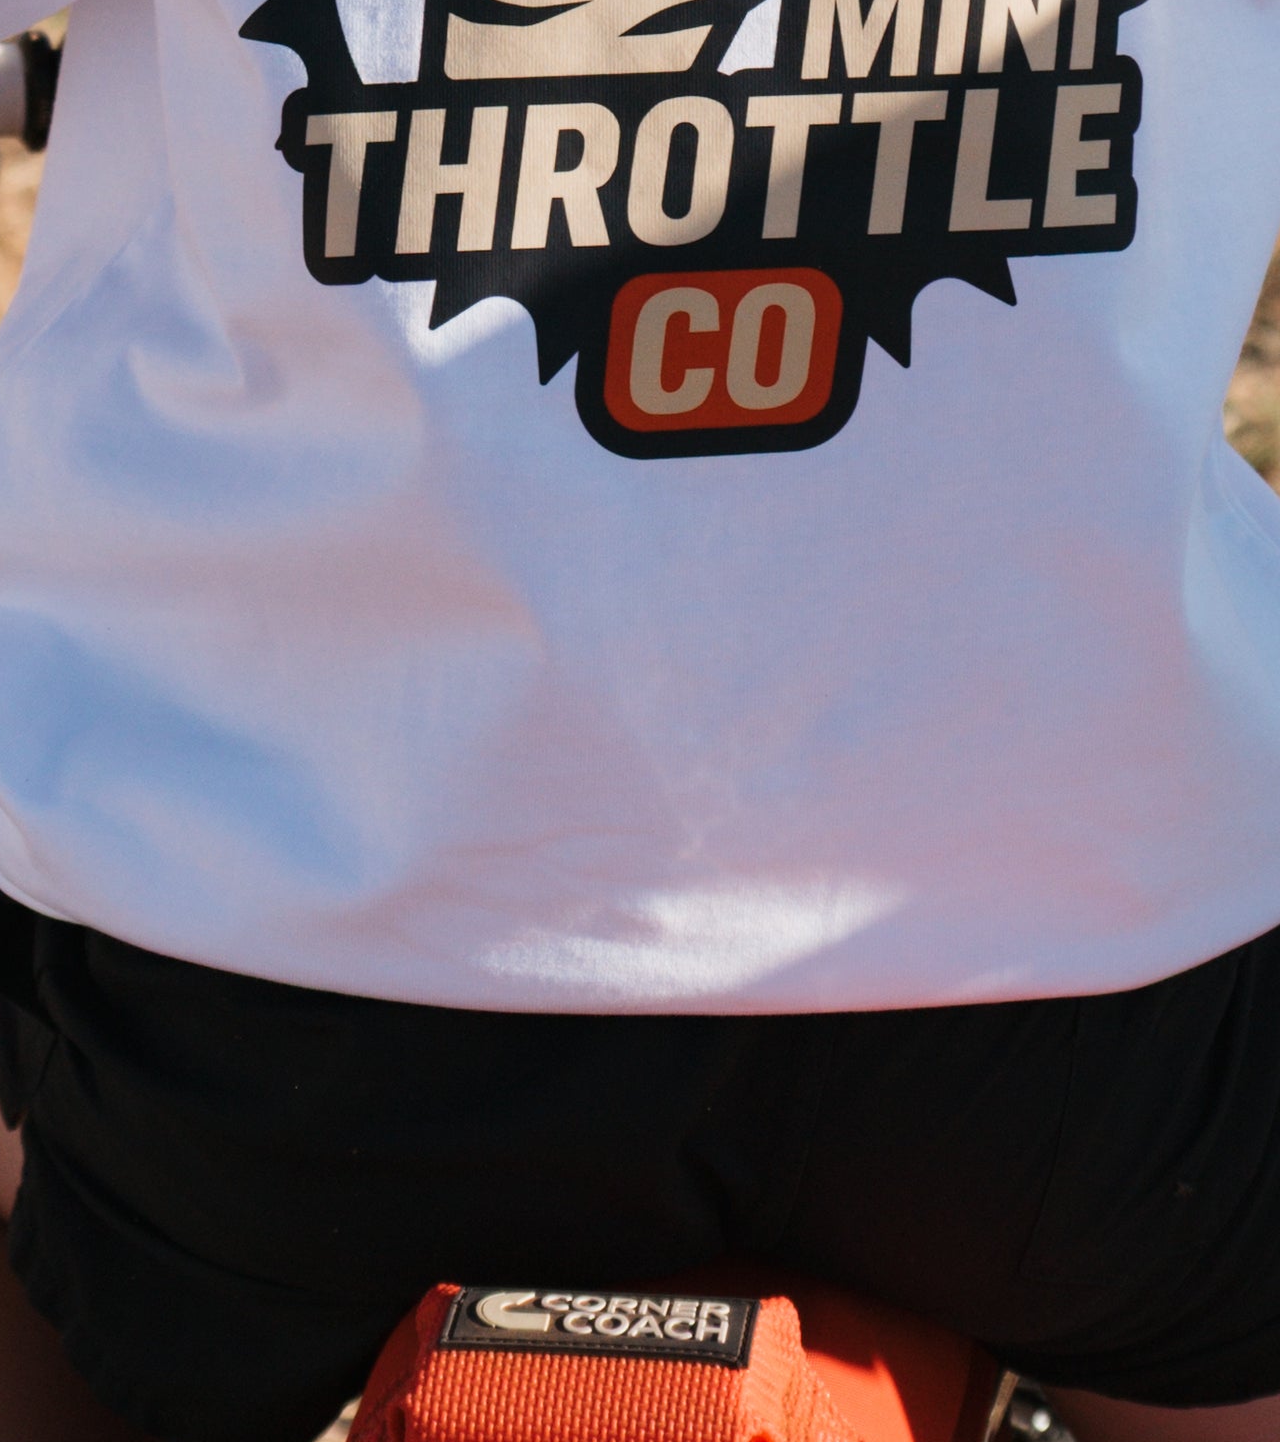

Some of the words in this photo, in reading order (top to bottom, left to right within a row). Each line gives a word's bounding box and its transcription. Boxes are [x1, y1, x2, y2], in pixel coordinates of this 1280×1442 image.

[305, 82, 1123, 259] THROTTLE
[628, 282, 818, 416] CO
[541, 1293, 731, 1320] CORNER
[563, 1313, 730, 1344] COACH
